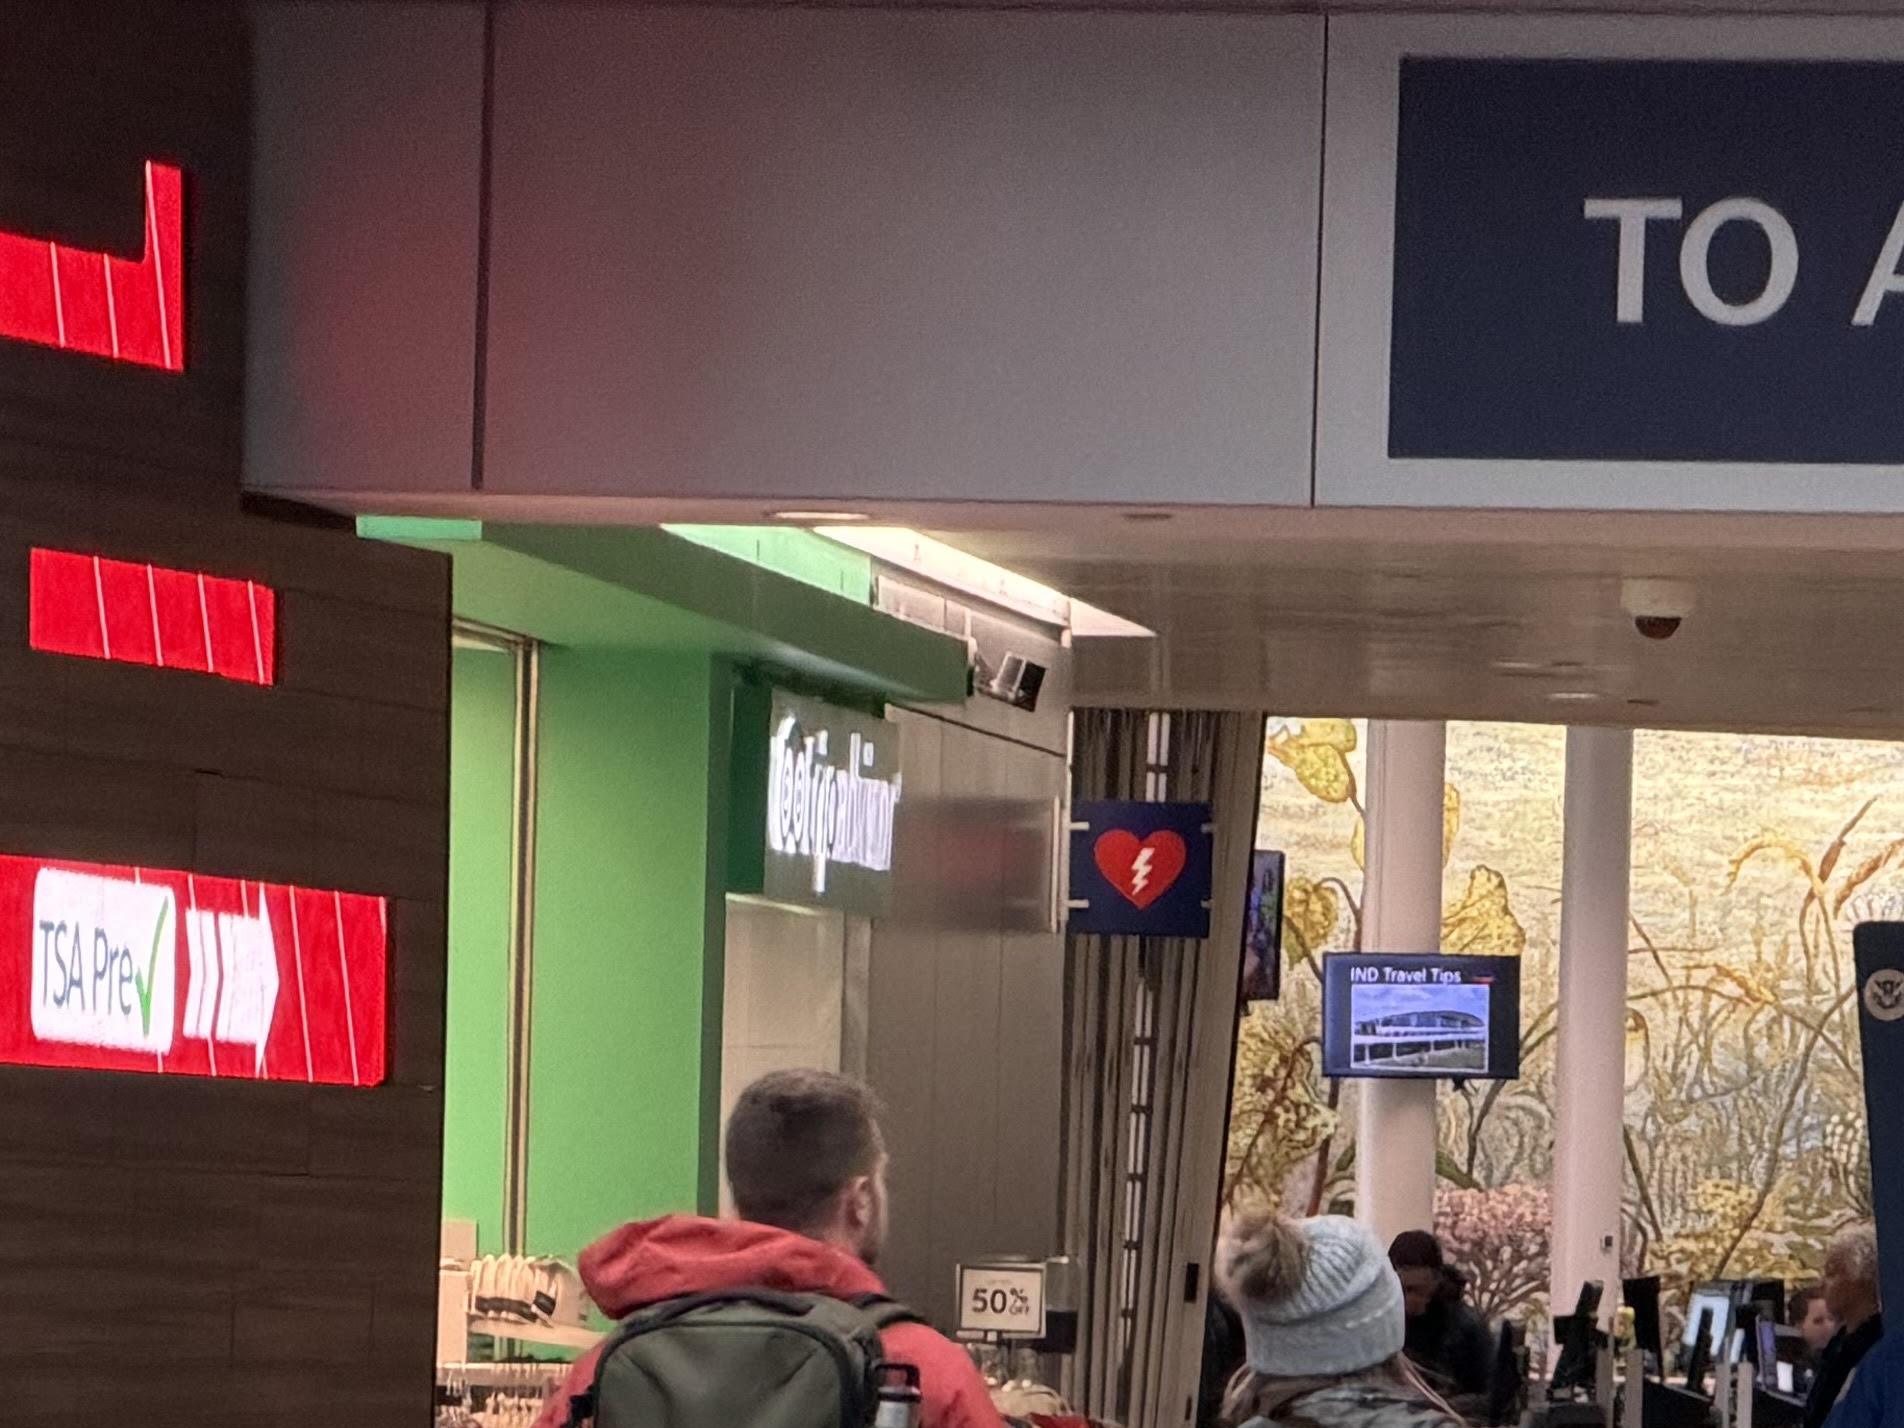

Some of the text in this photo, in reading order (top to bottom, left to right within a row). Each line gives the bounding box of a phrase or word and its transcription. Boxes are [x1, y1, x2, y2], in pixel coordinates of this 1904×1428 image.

[1583, 197, 1799, 326] TO
[39, 920, 133, 1016] TSA Pre
[1350, 966, 1462, 985] IND Travel Tips
